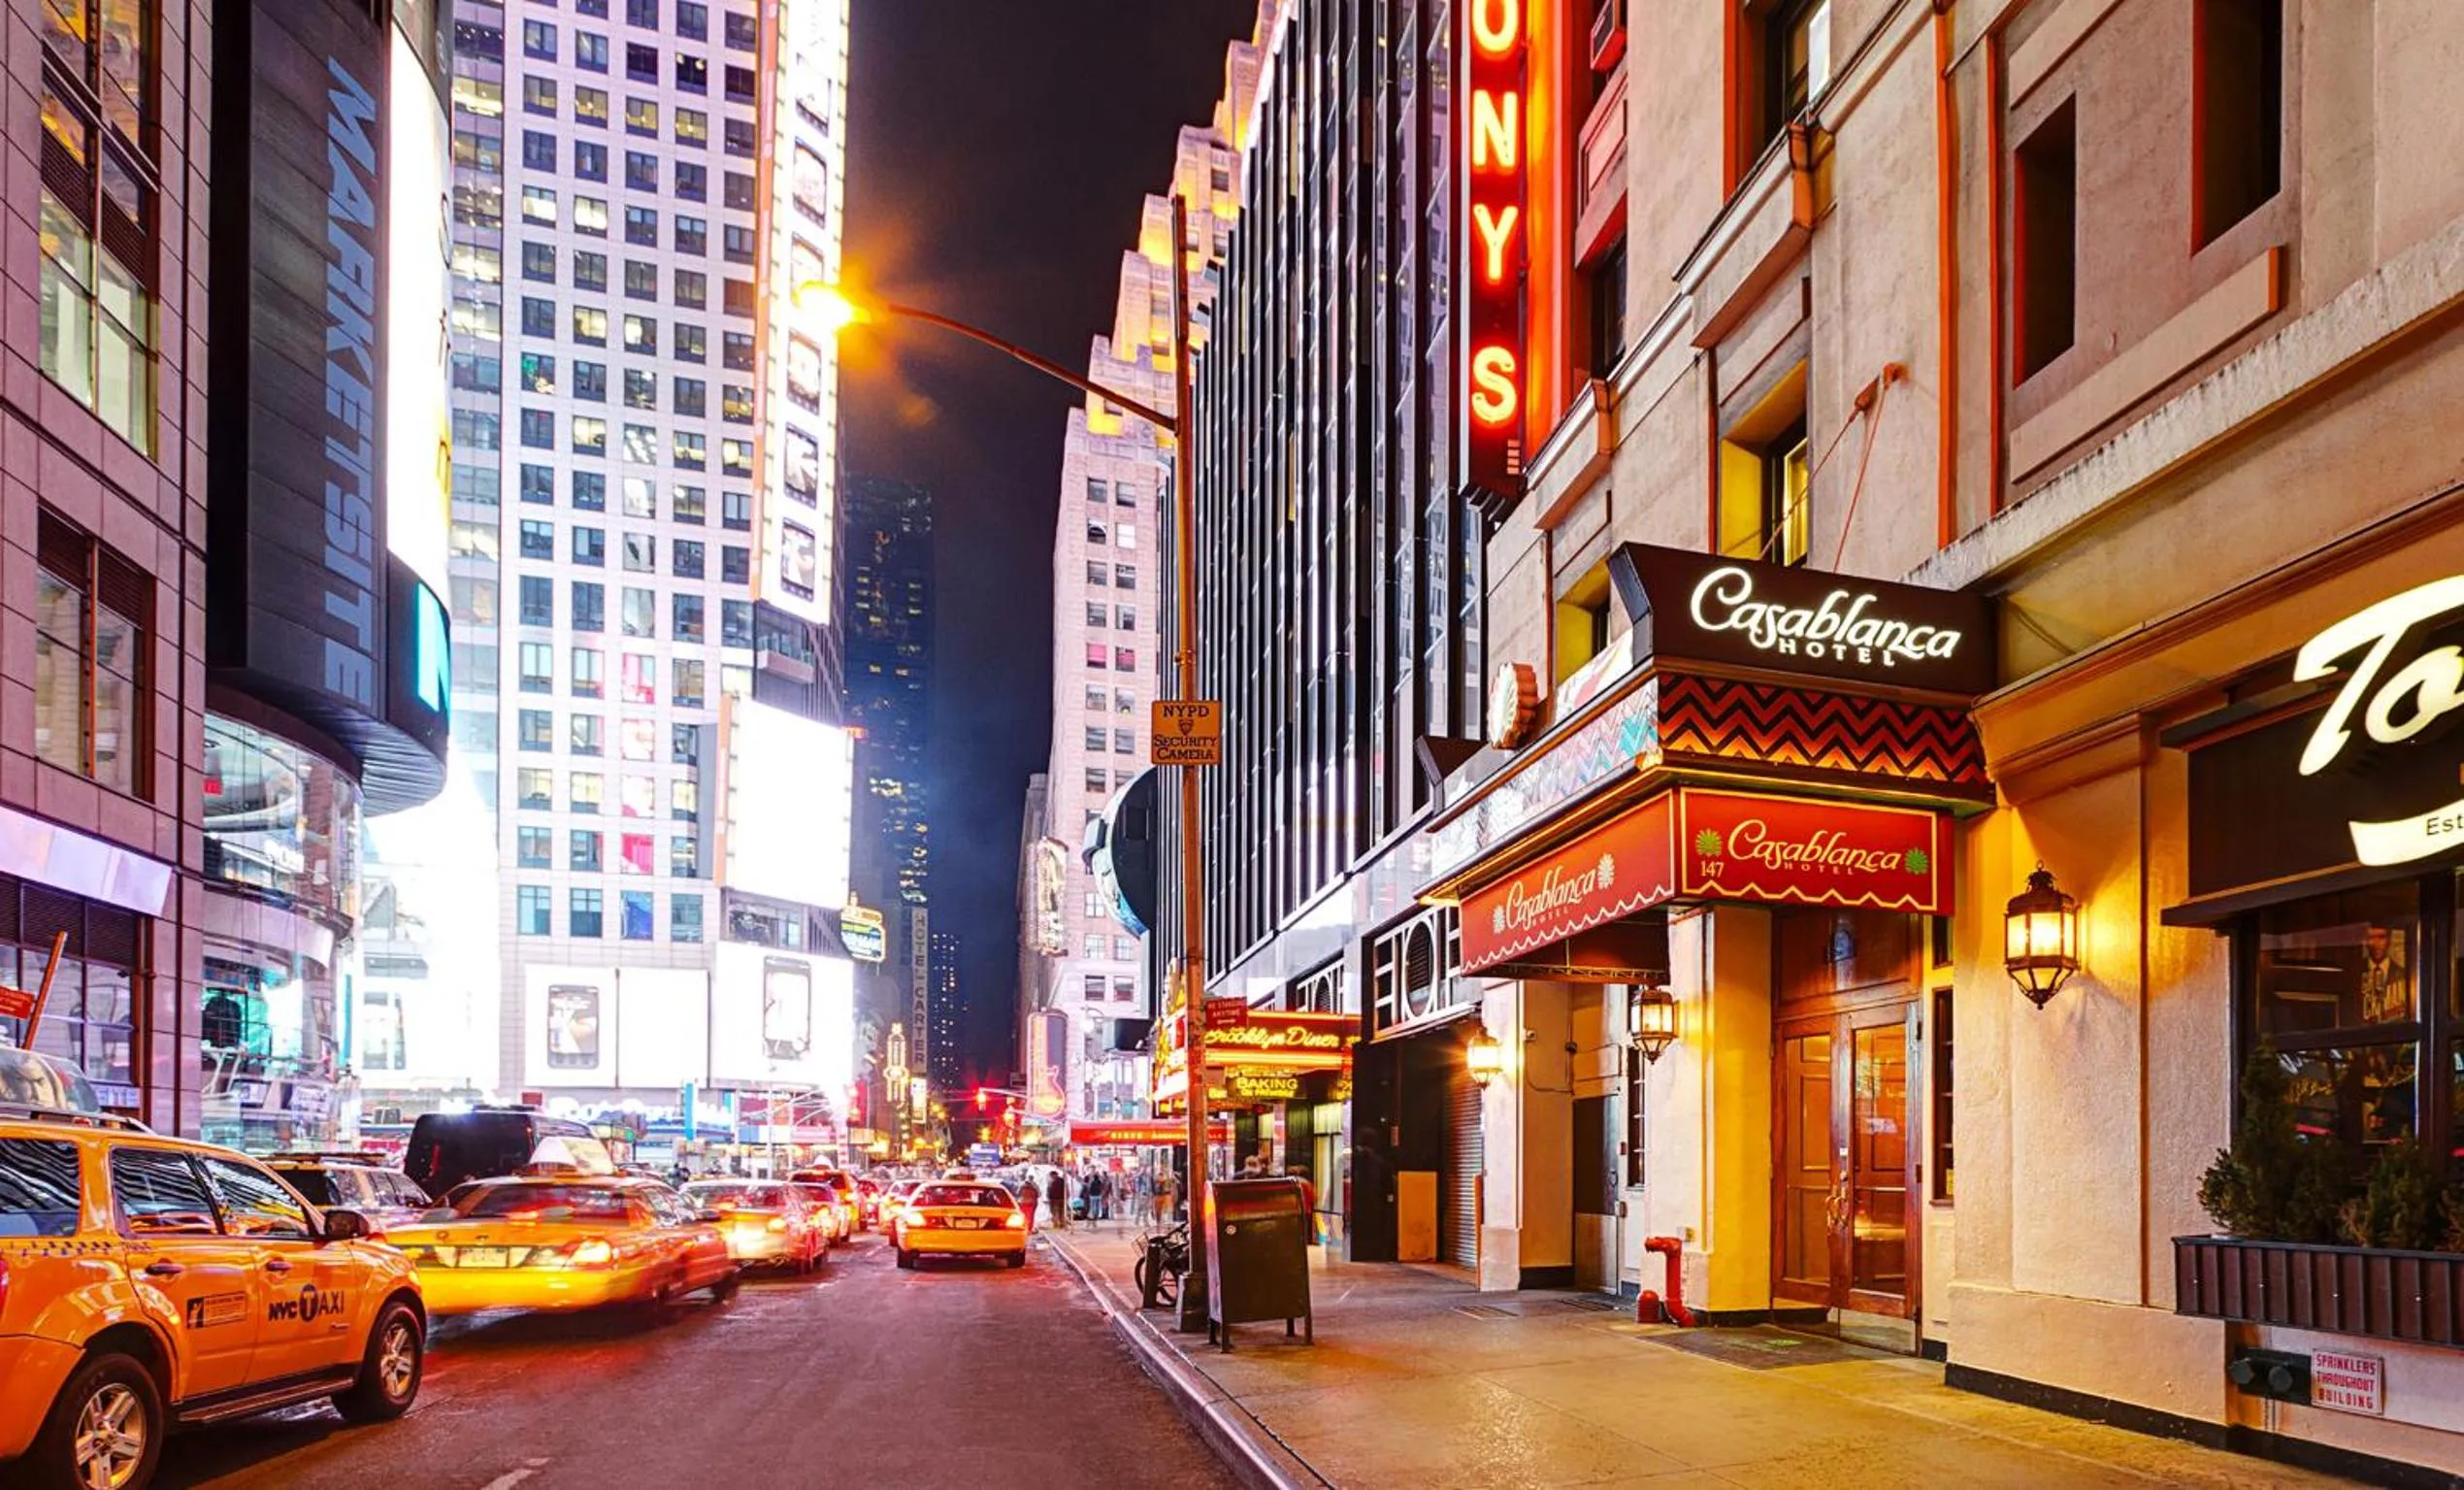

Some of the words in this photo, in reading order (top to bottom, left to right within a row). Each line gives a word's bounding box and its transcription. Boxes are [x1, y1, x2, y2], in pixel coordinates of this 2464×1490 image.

[324, 55, 377, 708] MARKETSITE
[1690, 566, 1961, 660] Casablanca
[1778, 637, 1896, 667] HOTEL
[1163, 705, 1210, 717] NYPD
[1154, 734, 1217, 747] SECURITY
[1157, 746, 1213, 760] CAMERA
[1727, 818, 1902, 874] Casablanca
[1700, 860, 1725, 878] 147
[1784, 862, 1855, 877] HOTEL
[1506, 865, 1596, 932] Casablanca
[914, 986, 926, 1064] CARTER
[1287, 1026, 1339, 1047] Diner
[1236, 1076, 1298, 1089] BAKING
[268, 1300, 298, 1321] NYC
[2316, 1353, 2377, 1375] SPRINKLERS
[2316, 1371, 2375, 1393] THROUGHOUT
[2318, 1388, 2374, 1409] BUILDING
